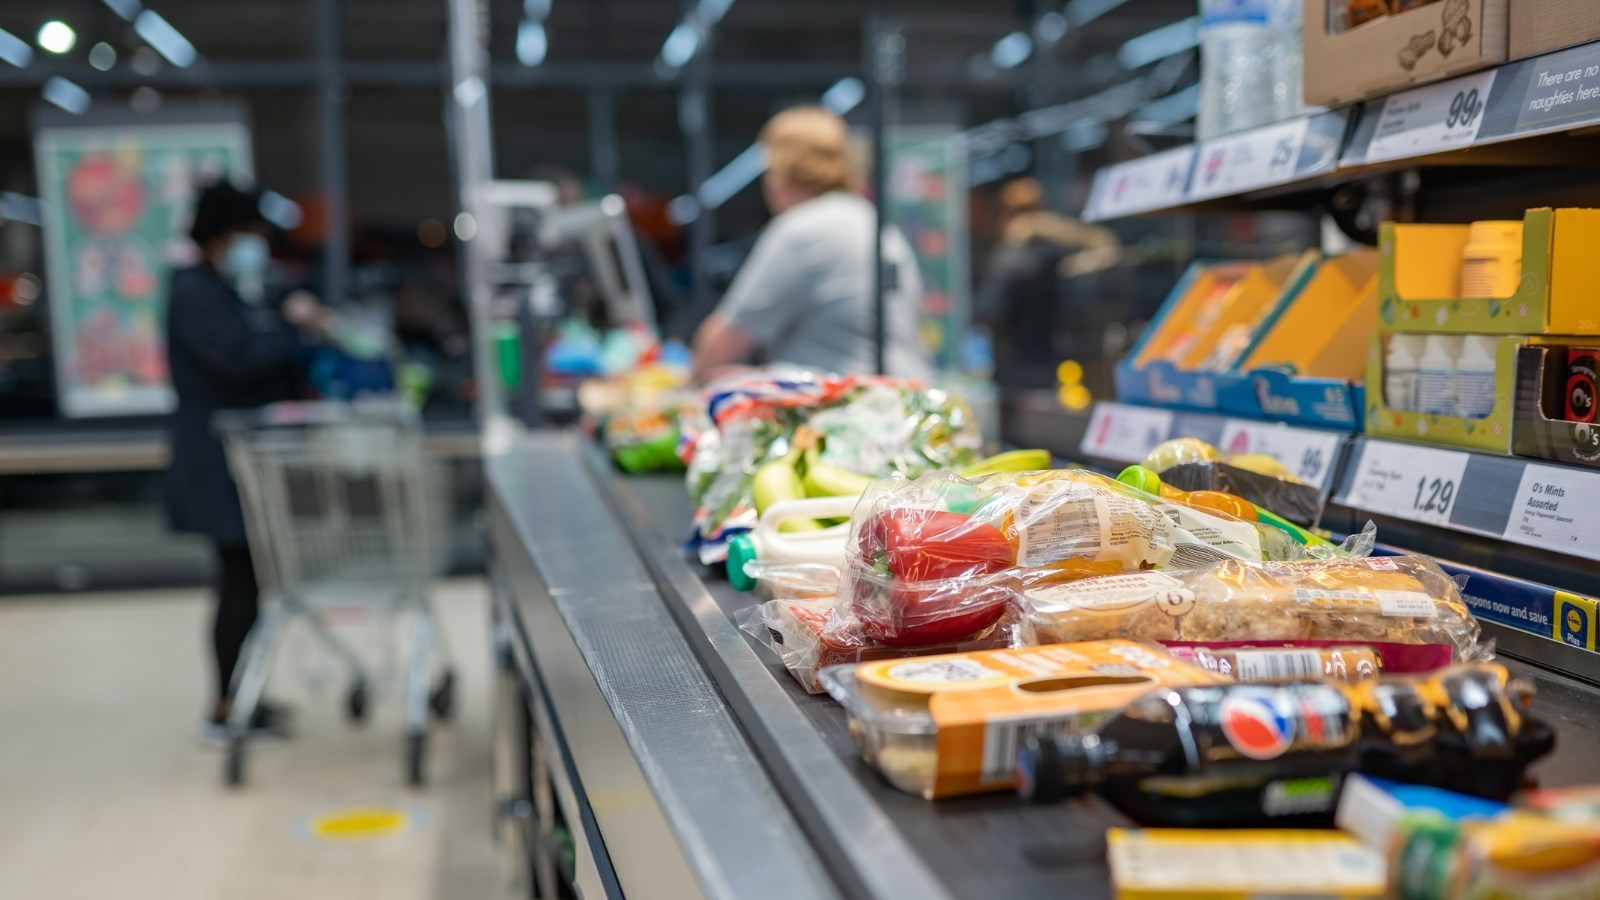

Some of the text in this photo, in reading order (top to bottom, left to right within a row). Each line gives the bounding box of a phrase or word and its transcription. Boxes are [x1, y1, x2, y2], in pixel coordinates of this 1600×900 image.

[1537, 65, 1599, 88] There are no
[1447, 88, 1483, 129] 99p
[1529, 83, 1600, 111] naughties here.
[1572, 387, 1592, 408] O's
[1575, 422, 1599, 446] O's
[1413, 475, 1454, 515] 1.29
[1532, 482, 1566, 498] O's Mints
[1527, 497, 1559, 511] Assorted
[1166, 590, 1184, 606] 6
[1493, 601, 1510, 614] now
[1511, 607, 1528, 620] and
[1528, 611, 1548, 625] save
[1567, 632, 1580, 647] Plus
